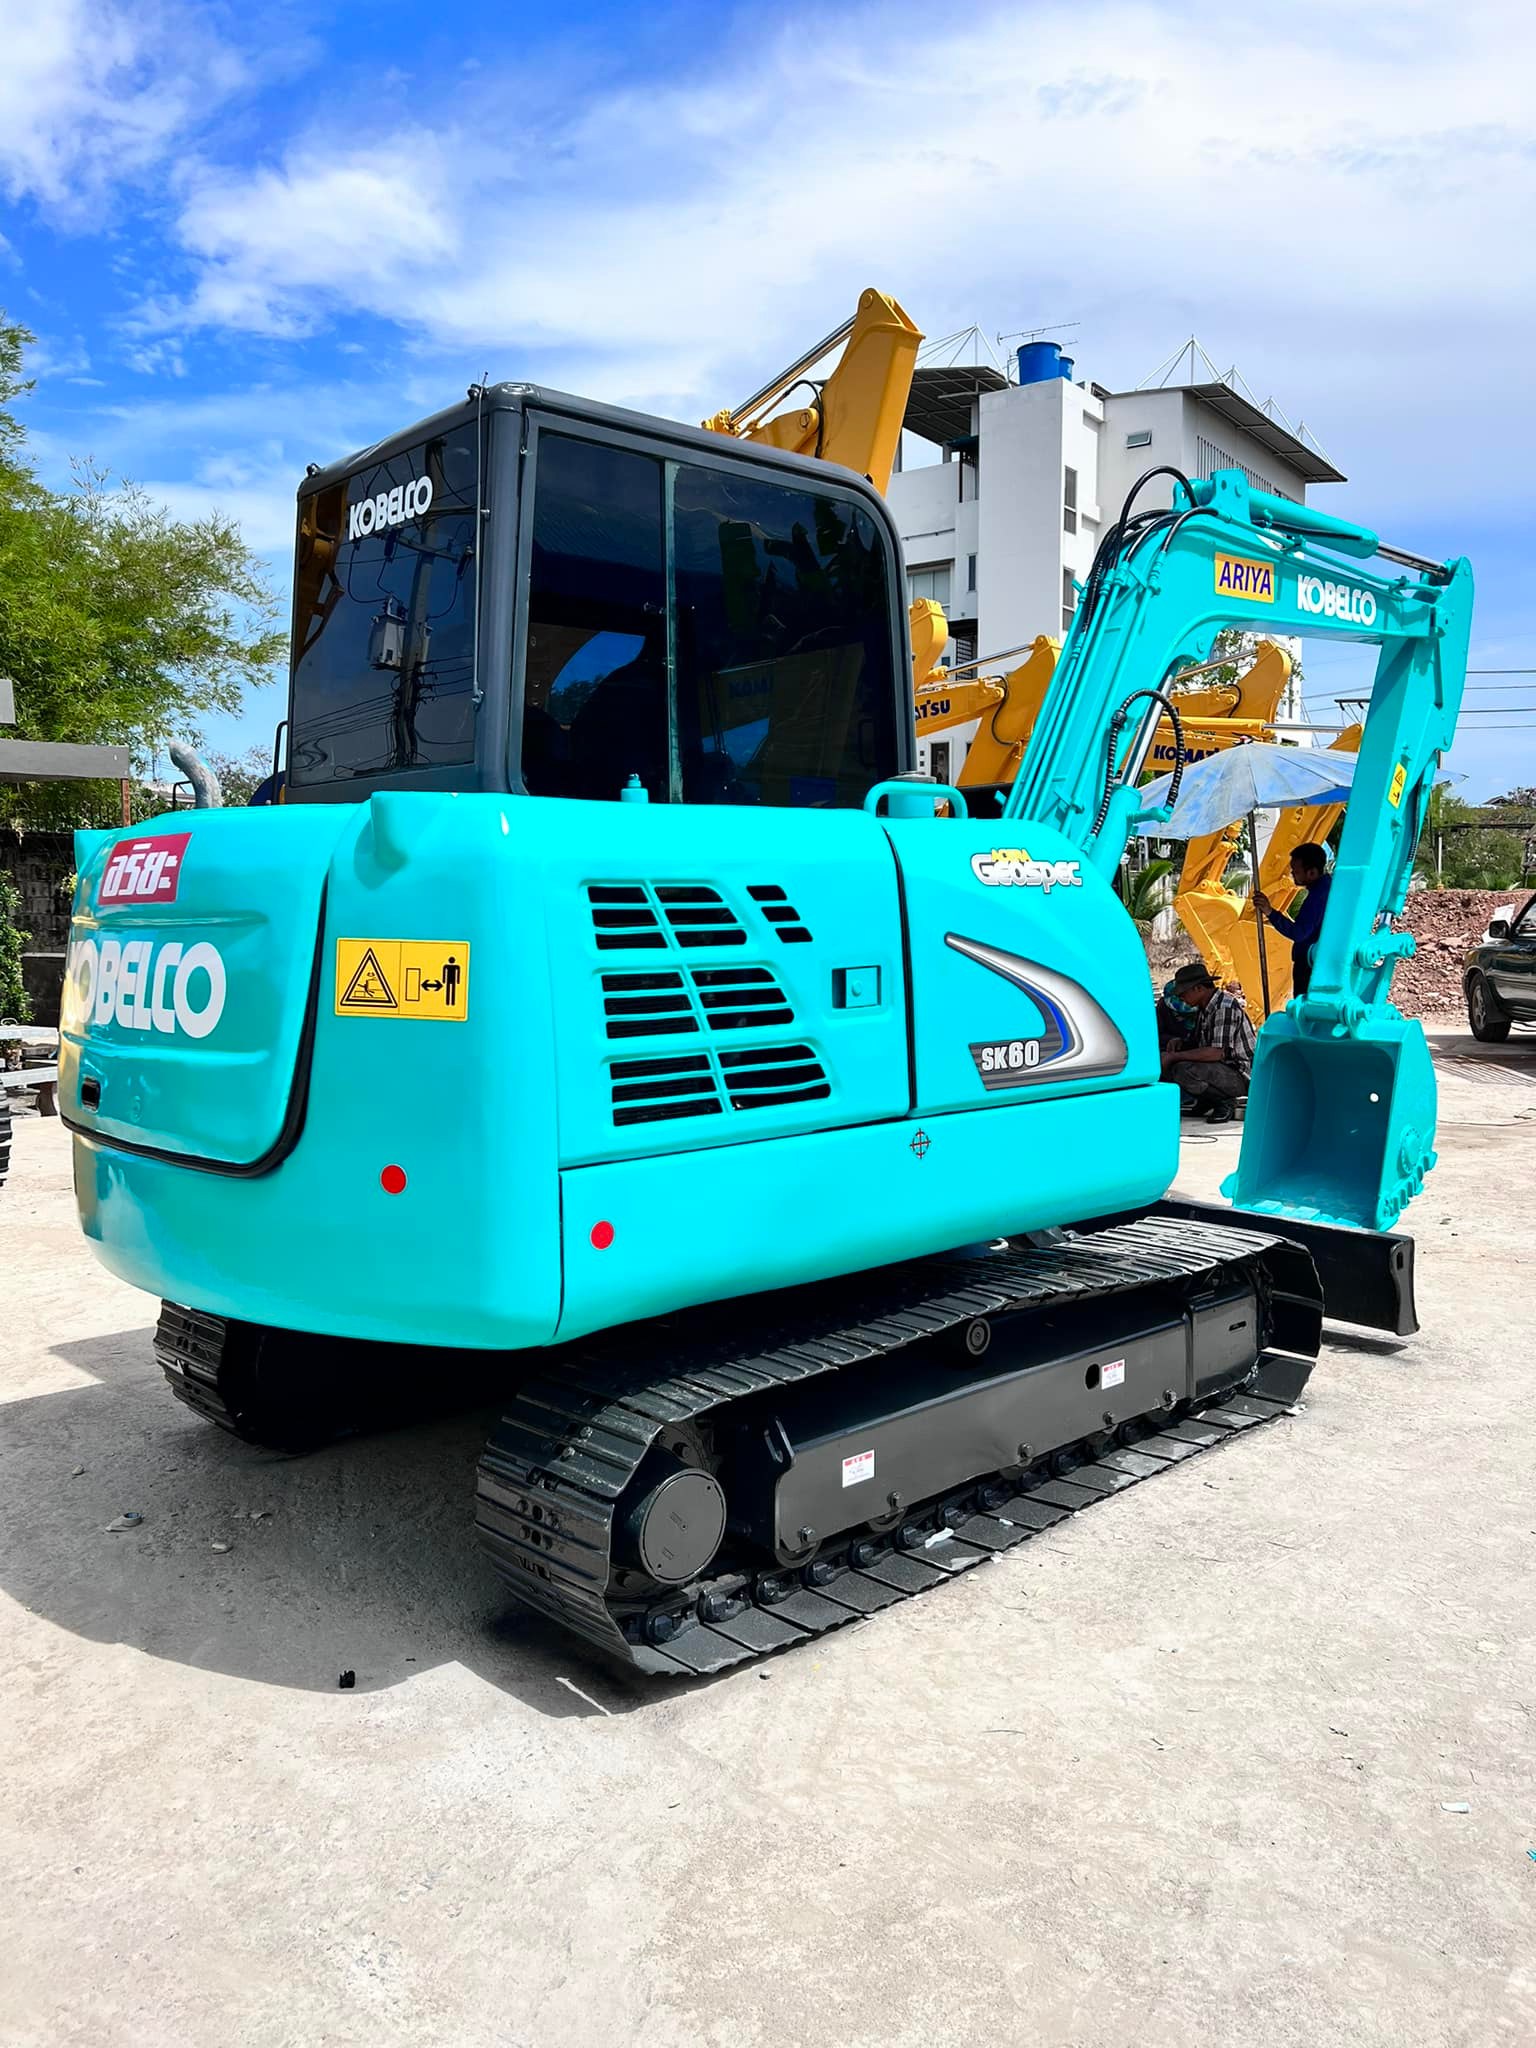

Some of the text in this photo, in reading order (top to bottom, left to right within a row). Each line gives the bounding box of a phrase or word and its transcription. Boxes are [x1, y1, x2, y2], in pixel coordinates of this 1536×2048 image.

[349, 475, 433, 541] KOBELCO
[1219, 561, 1271, 596] ARIYA
[1297, 574, 1377, 627] KOBELCO
[981, 1040, 1040, 1071] SK60
